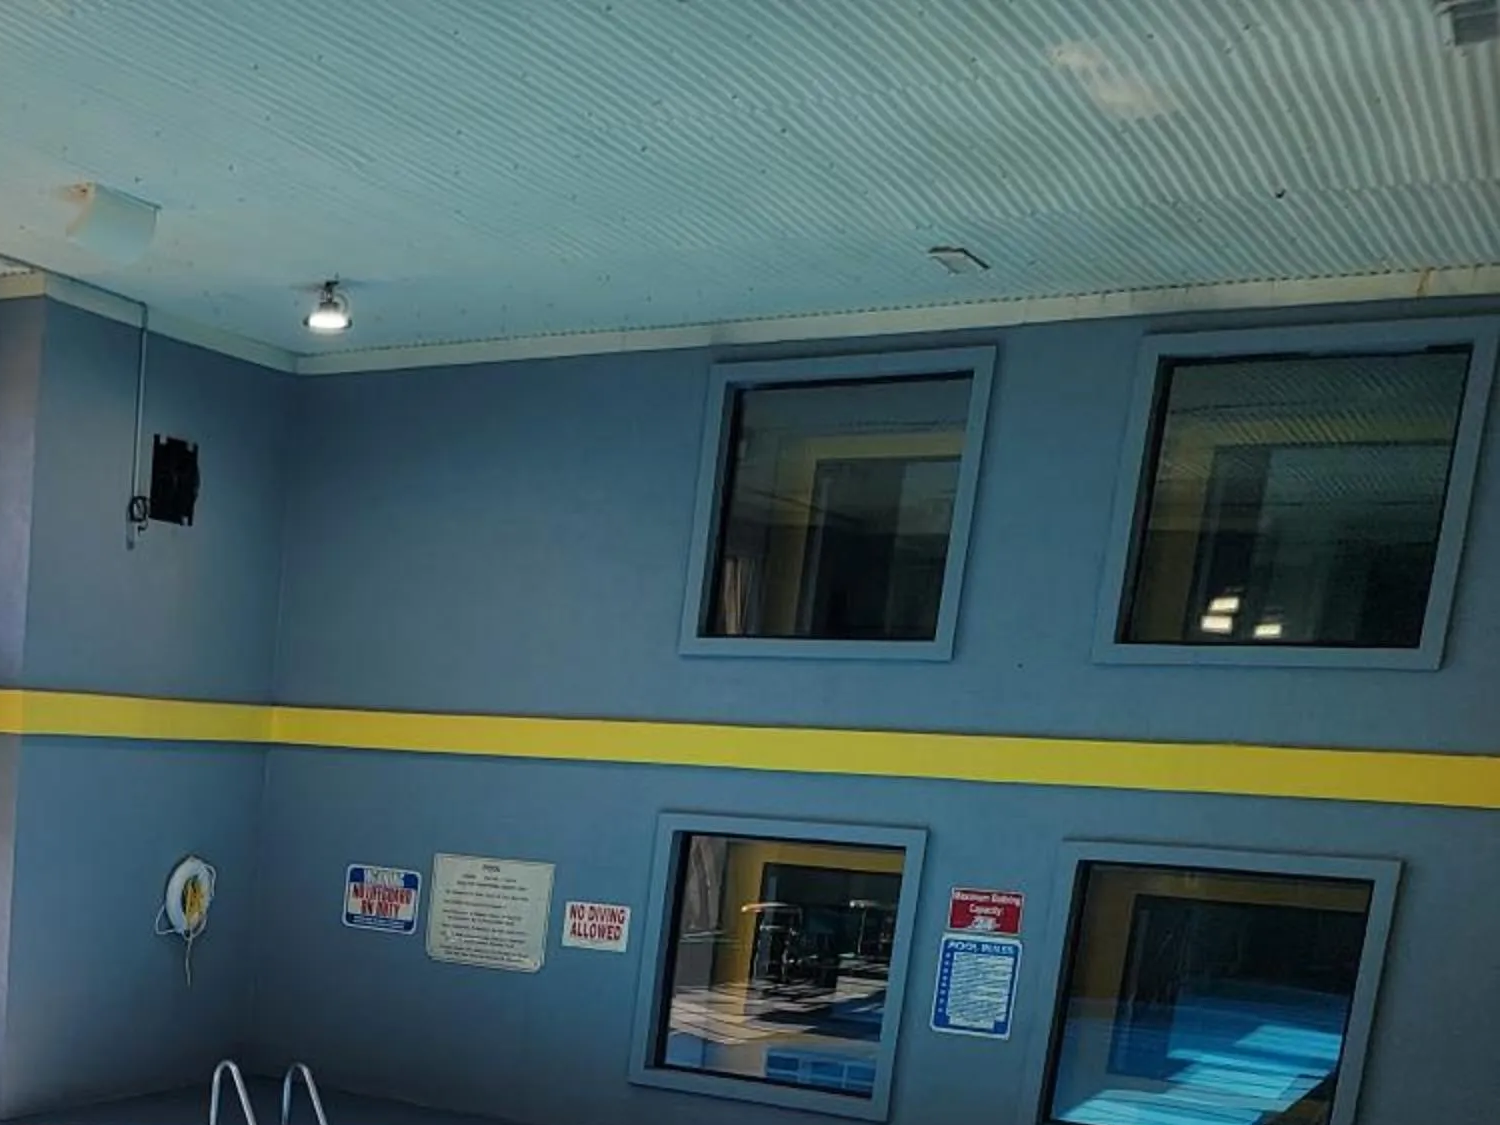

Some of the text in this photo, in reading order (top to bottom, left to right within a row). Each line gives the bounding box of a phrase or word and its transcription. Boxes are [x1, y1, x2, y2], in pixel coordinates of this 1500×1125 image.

[570, 903, 625, 924] NO DIVING
[570, 922, 622, 941] ALLOWED
[947, 941, 978, 954] POOL
